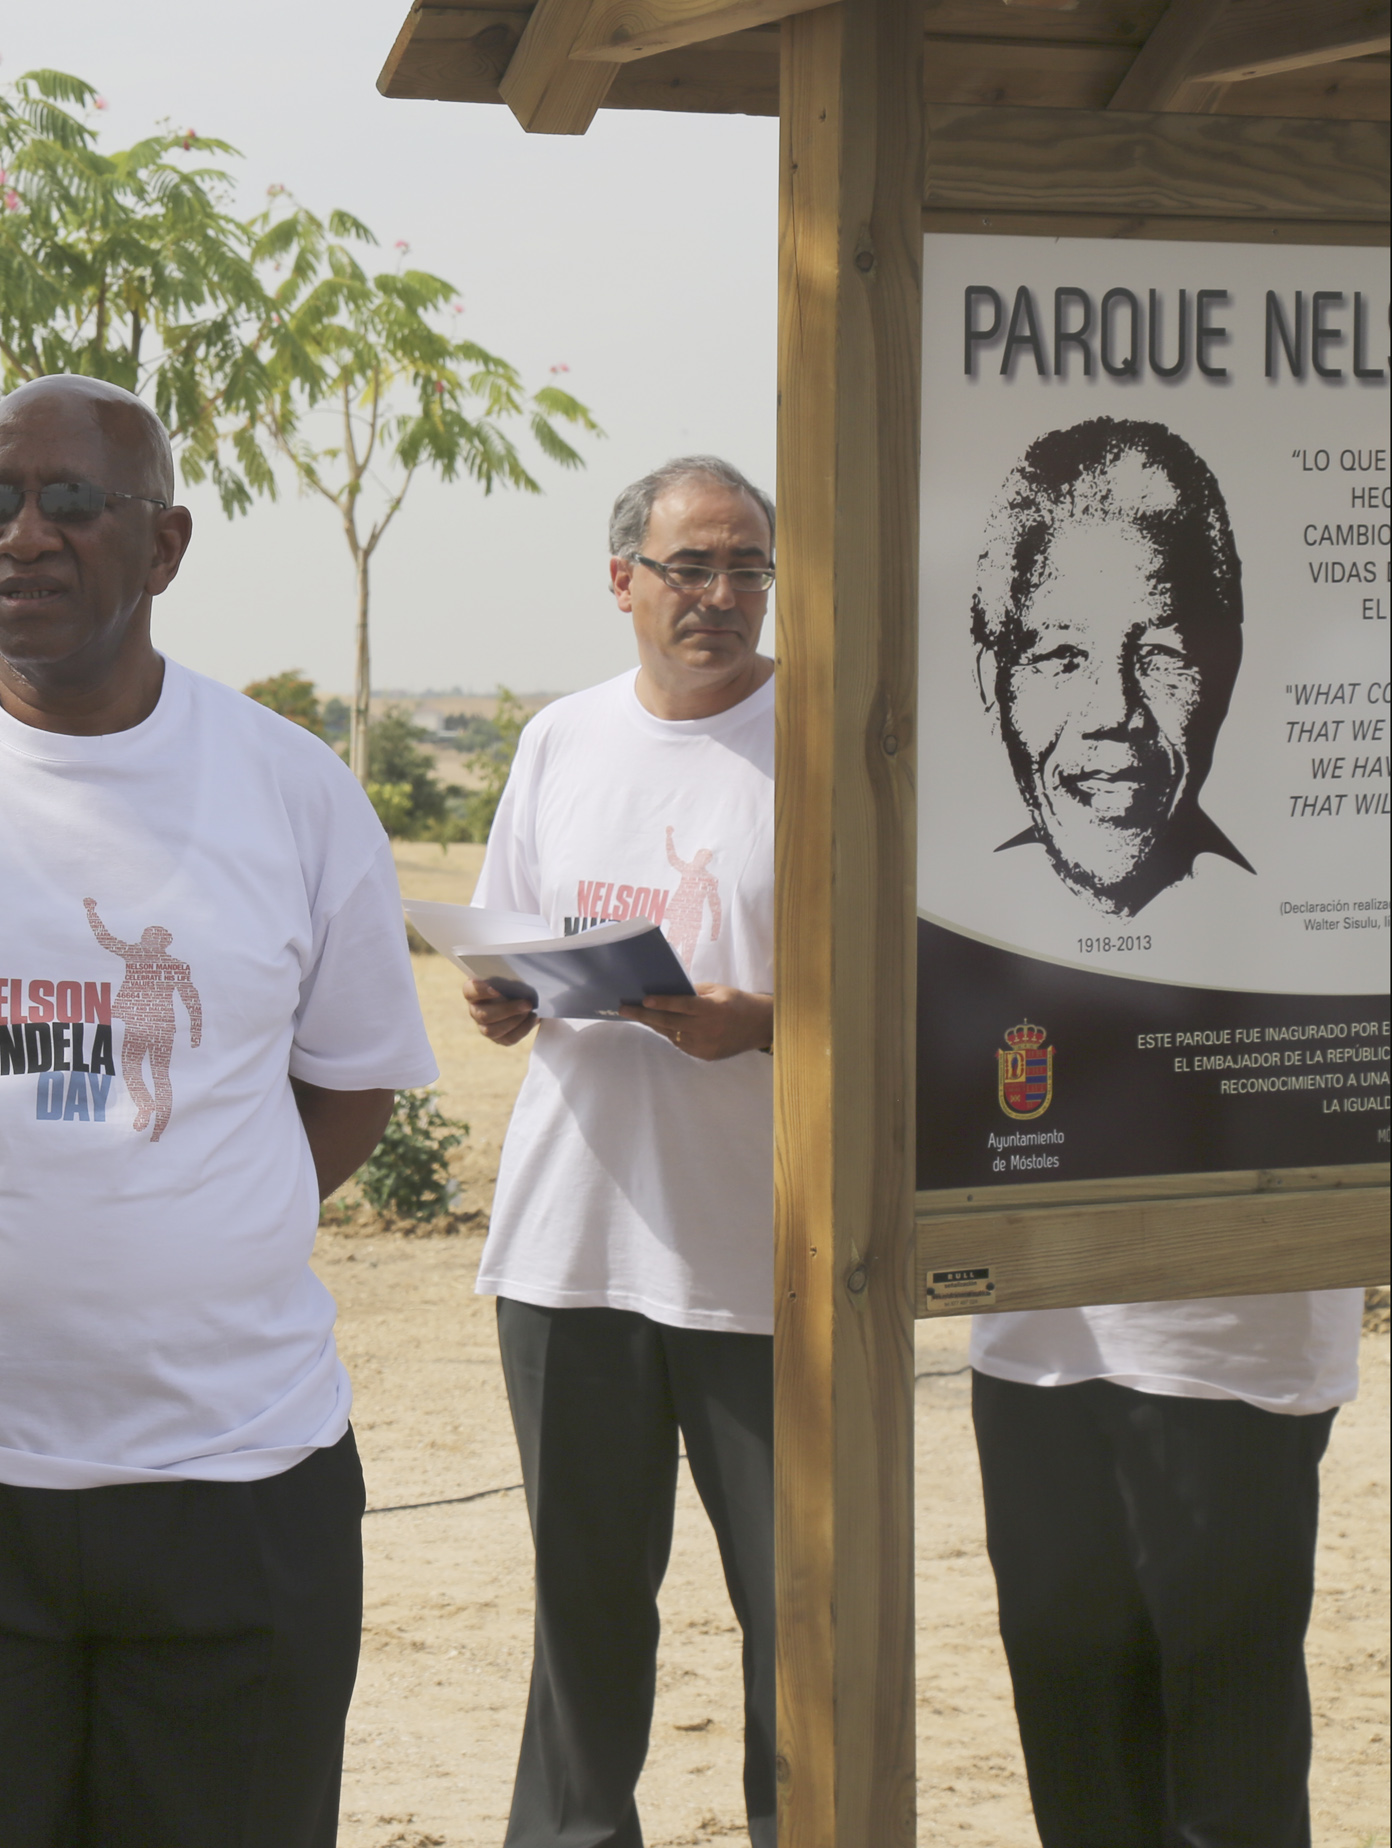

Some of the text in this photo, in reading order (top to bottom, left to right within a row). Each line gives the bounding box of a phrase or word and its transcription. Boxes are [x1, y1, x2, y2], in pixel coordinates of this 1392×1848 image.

[964, 285, 1390, 379] PARQUE NEL
[1340, 449, 1386, 471] QUE
[1304, 524, 1390, 546] CAMBIO
[1309, 561, 1376, 583] VIDAS
[1363, 598, 1387, 619] EL
[1287, 719, 1386, 743] THAT WE
[1312, 757, 1346, 779] WE
[1290, 794, 1348, 817] THAT
[577, 880, 669, 926] NELSON
[1280, 898, 1390, 916] (Declaración realiza
[1304, 918, 1340, 931] Walter
[1343, 916, 1381, 930] Sisulu,
[1078, 935, 1152, 953] 1918-2013
[1138, 1033, 1172, 1049] ESTE
[1176, 1030, 1231, 1046] PARQUE
[1235, 1028, 1261, 1043] FUE
[1265, 1024, 1348, 1041] INAGURADO
[1351, 1022, 1378, 1037] POR
[1174, 1058, 1190, 1072] EL
[1194, 1052, 1281, 1071] EMBAJADOR
[1284, 1051, 1302, 1066] DE
[1306, 1050, 1323, 1065] LA
[1221, 1071, 1390, 1094] RECONOCIMIENTO A UNA
[36, 1071, 112, 1122] DAY
[1323, 1099, 1340, 1113] LA
[988, 1129, 1065, 1152] Ayuntamiento
[993, 1153, 1060, 1172] de Móstoles
